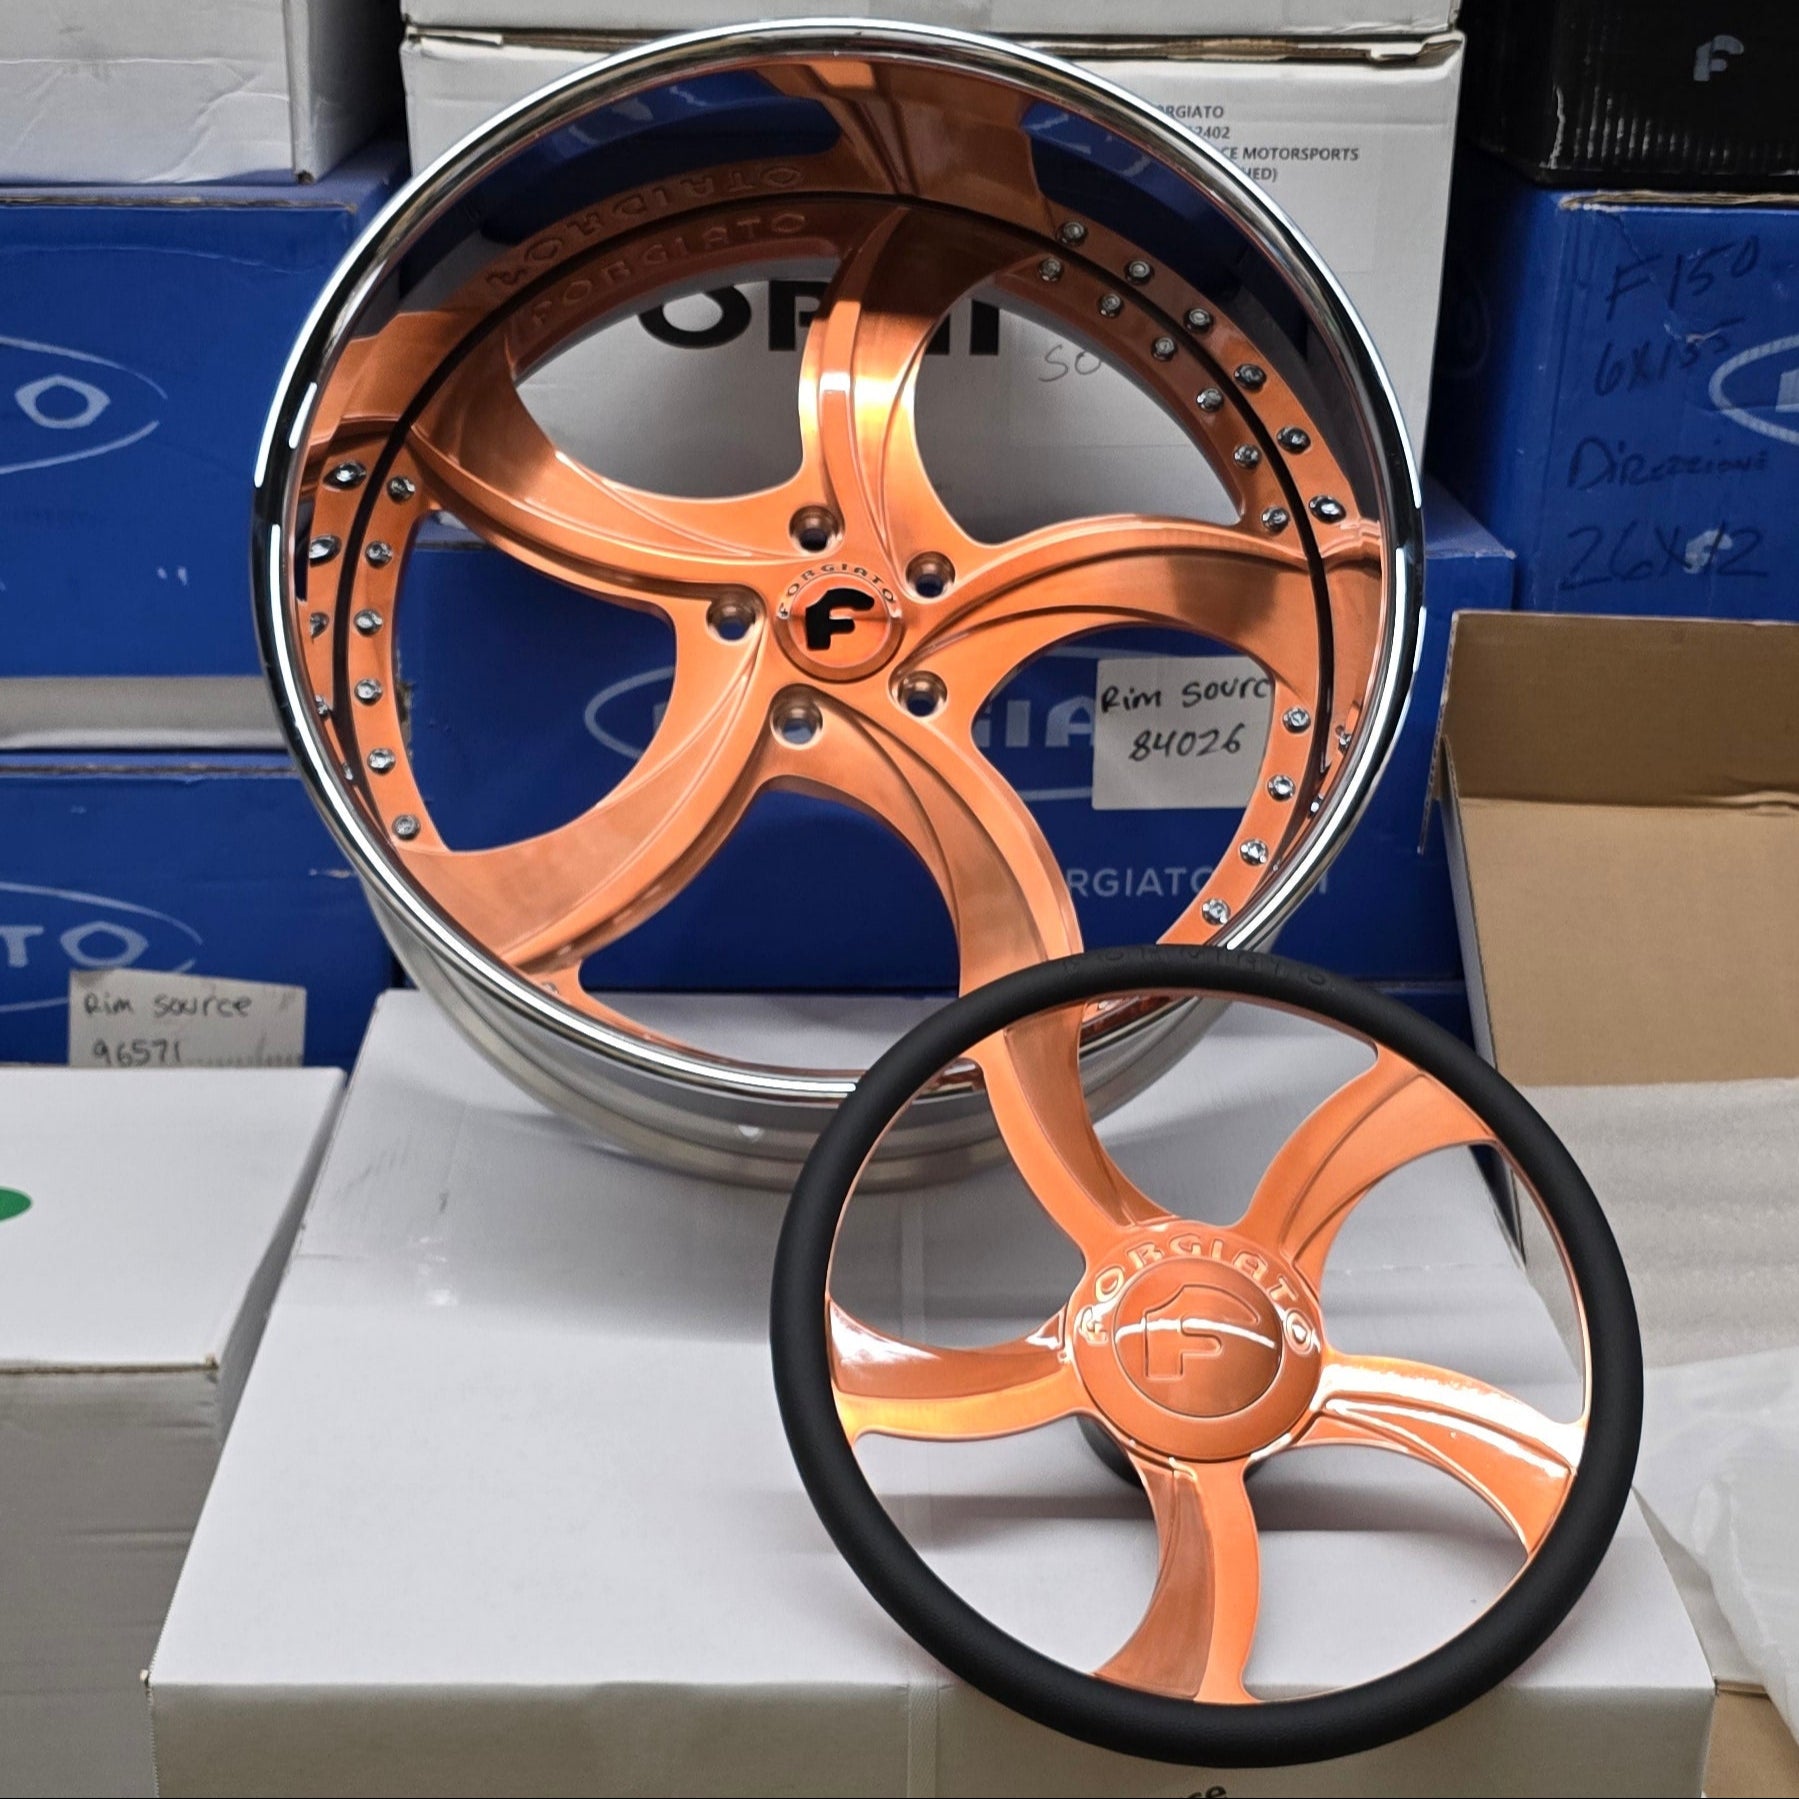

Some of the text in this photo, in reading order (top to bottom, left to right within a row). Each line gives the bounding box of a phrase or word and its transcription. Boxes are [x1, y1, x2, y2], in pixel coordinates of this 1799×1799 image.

[1243, 147, 1359, 161] MOTORSPORTS
[778, 562, 897, 618] FORGIATO
[1101, 685, 1161, 713] Rim
[1128, 722, 1245, 762] 84026
[92, 1038, 182, 1067] 96571
[1079, 1233, 1318, 1356] FORGIATO
